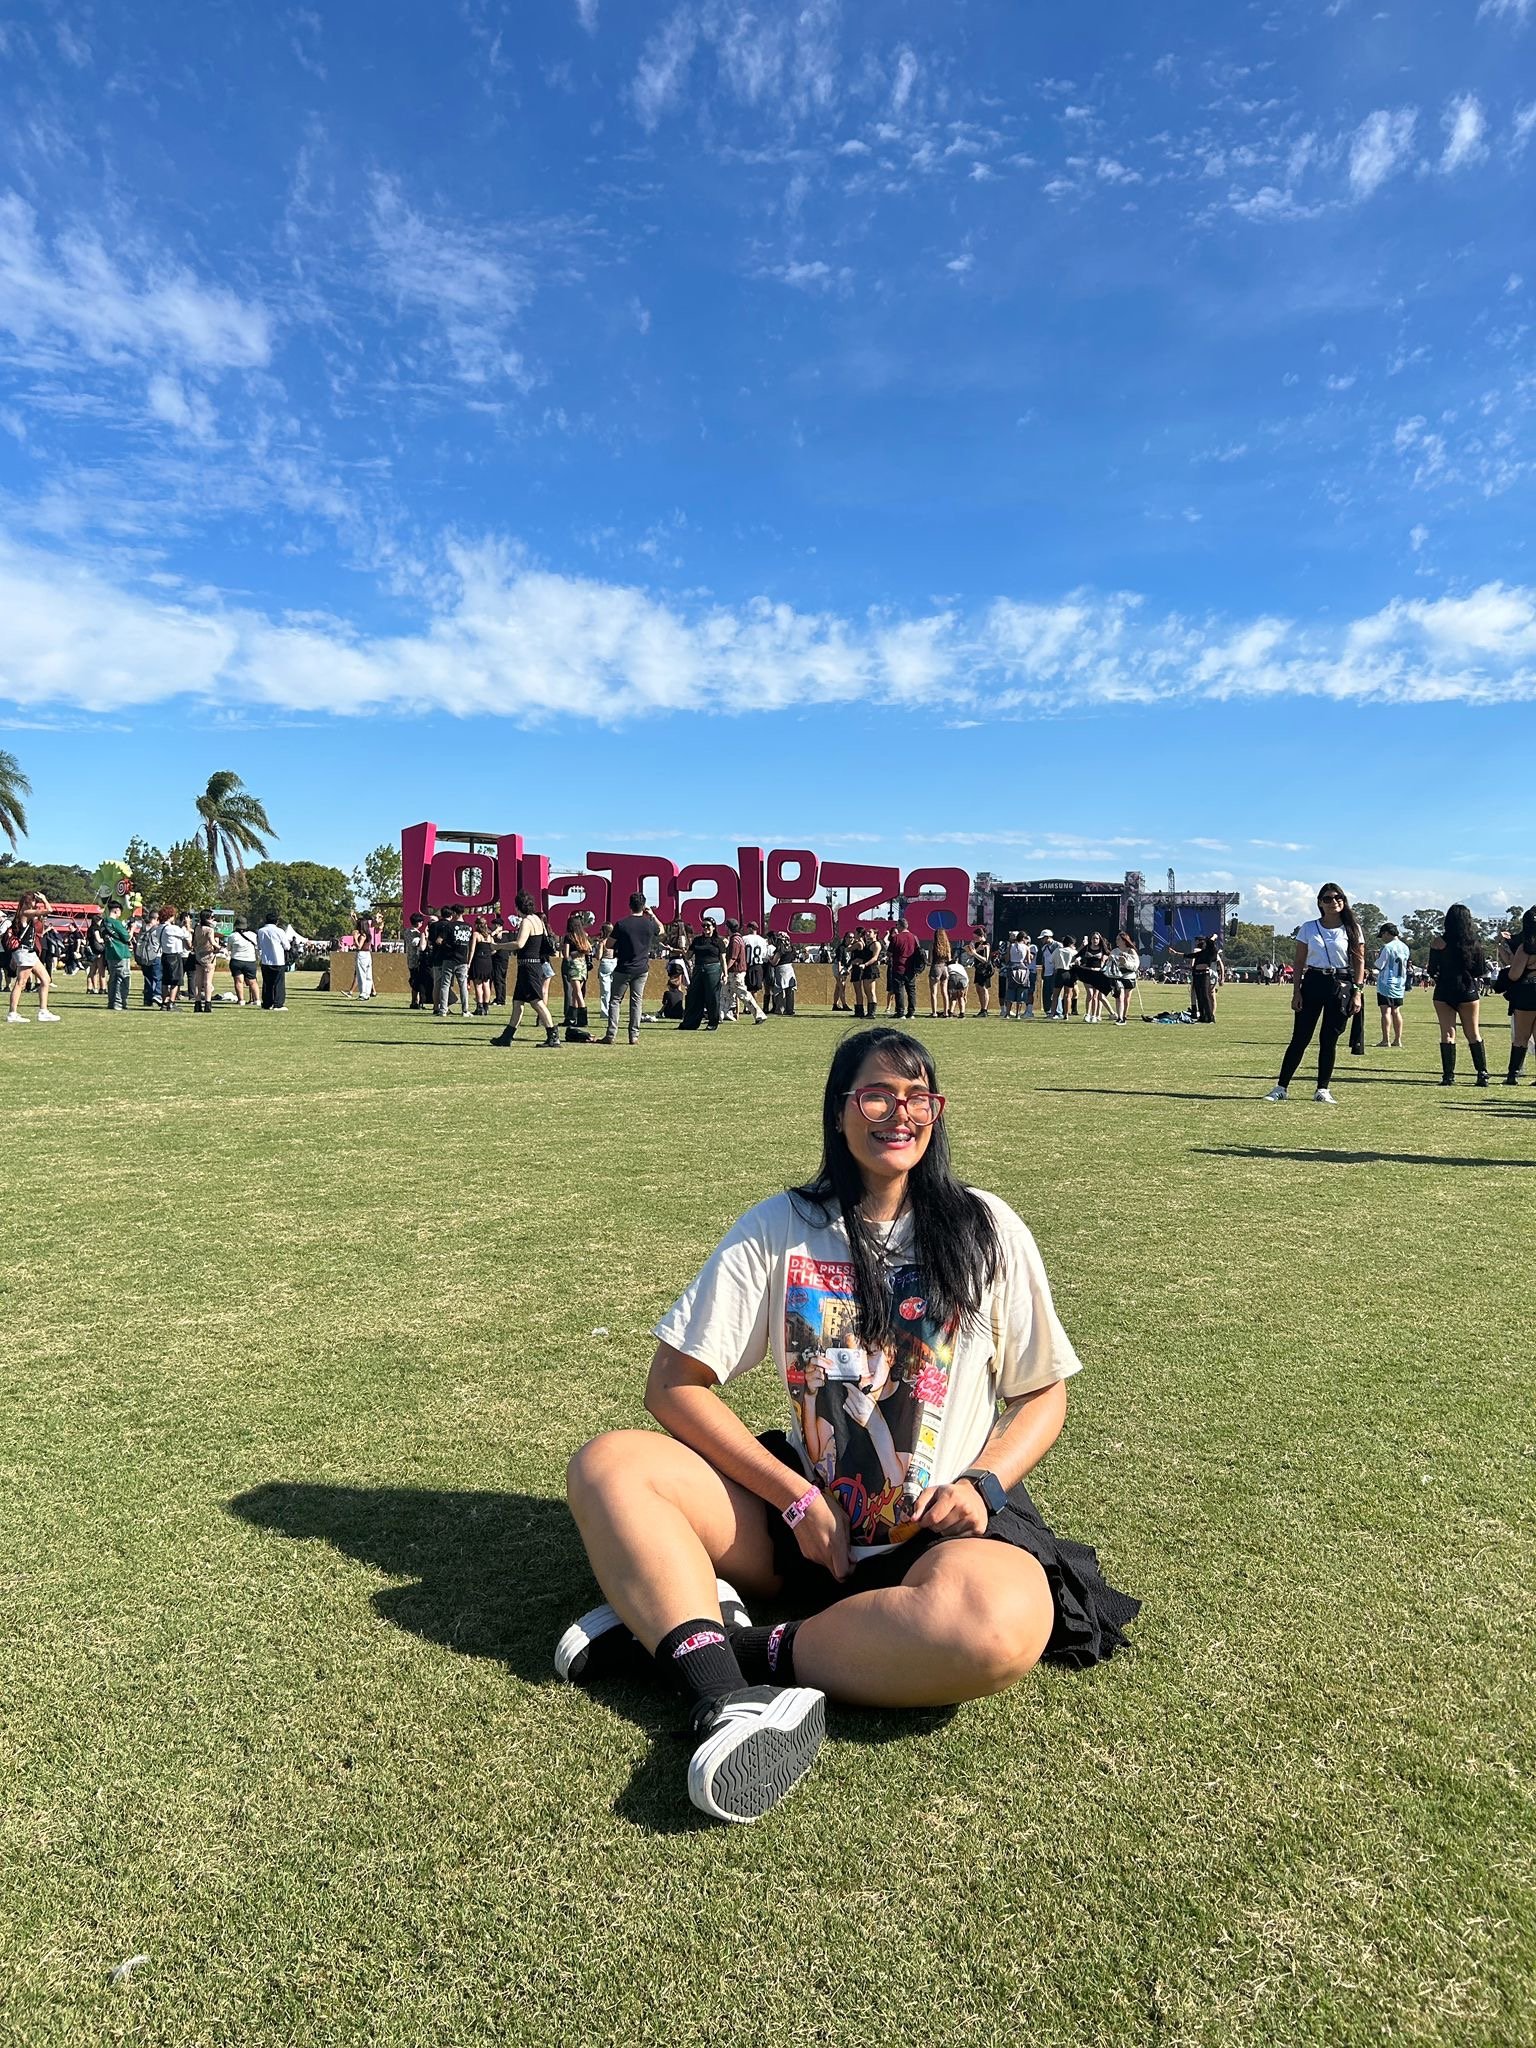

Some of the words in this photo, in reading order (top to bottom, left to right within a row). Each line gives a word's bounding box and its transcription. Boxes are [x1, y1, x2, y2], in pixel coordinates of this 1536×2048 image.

[790, 1258, 816, 1271] DJO
[819, 1263, 857, 1277] PRESE
[789, 1268, 825, 1288] THE
[830, 1274, 858, 1291] CR
